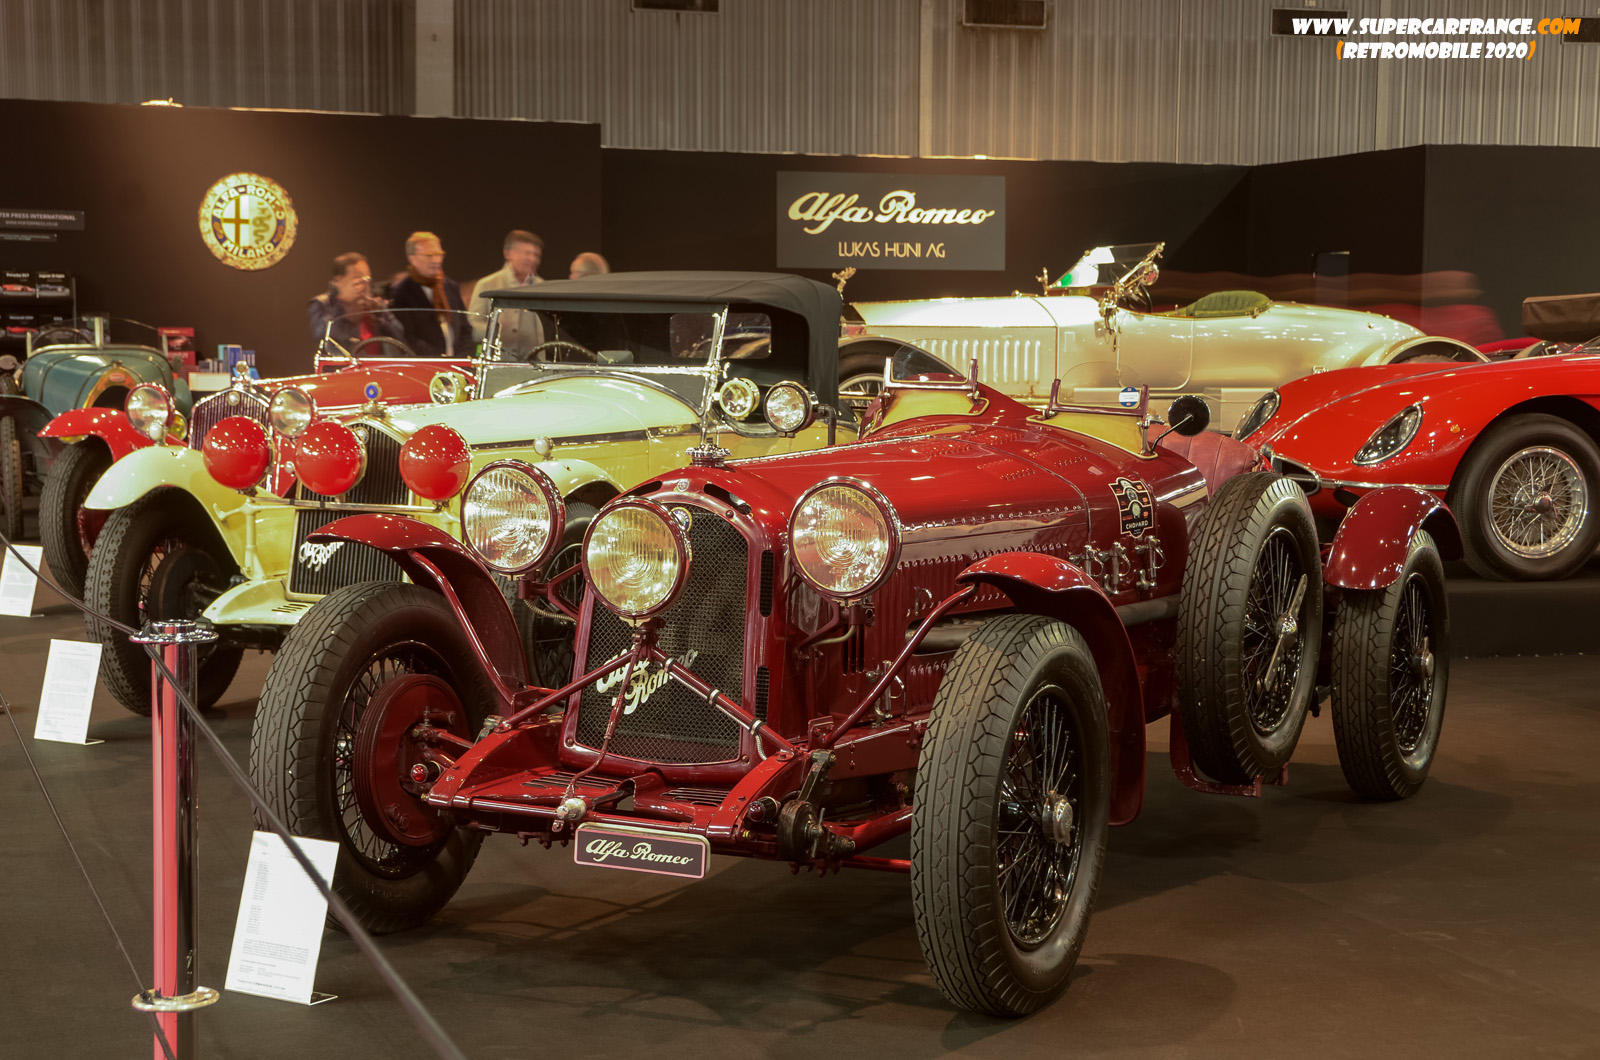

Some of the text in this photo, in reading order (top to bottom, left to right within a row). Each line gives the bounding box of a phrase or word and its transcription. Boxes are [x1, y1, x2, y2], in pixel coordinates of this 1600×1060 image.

[30, 213, 76, 221] INTERNATIONAL
[788, 190, 996, 235] Alfa Romeo
[222, 240, 275, 259] MILANO
[838, 241, 881, 257] LUKAS
[925, 242, 946, 258] AG
[1125, 520, 1149, 530] CHOPARD
[585, 839, 694, 865] Alfa Romeo
